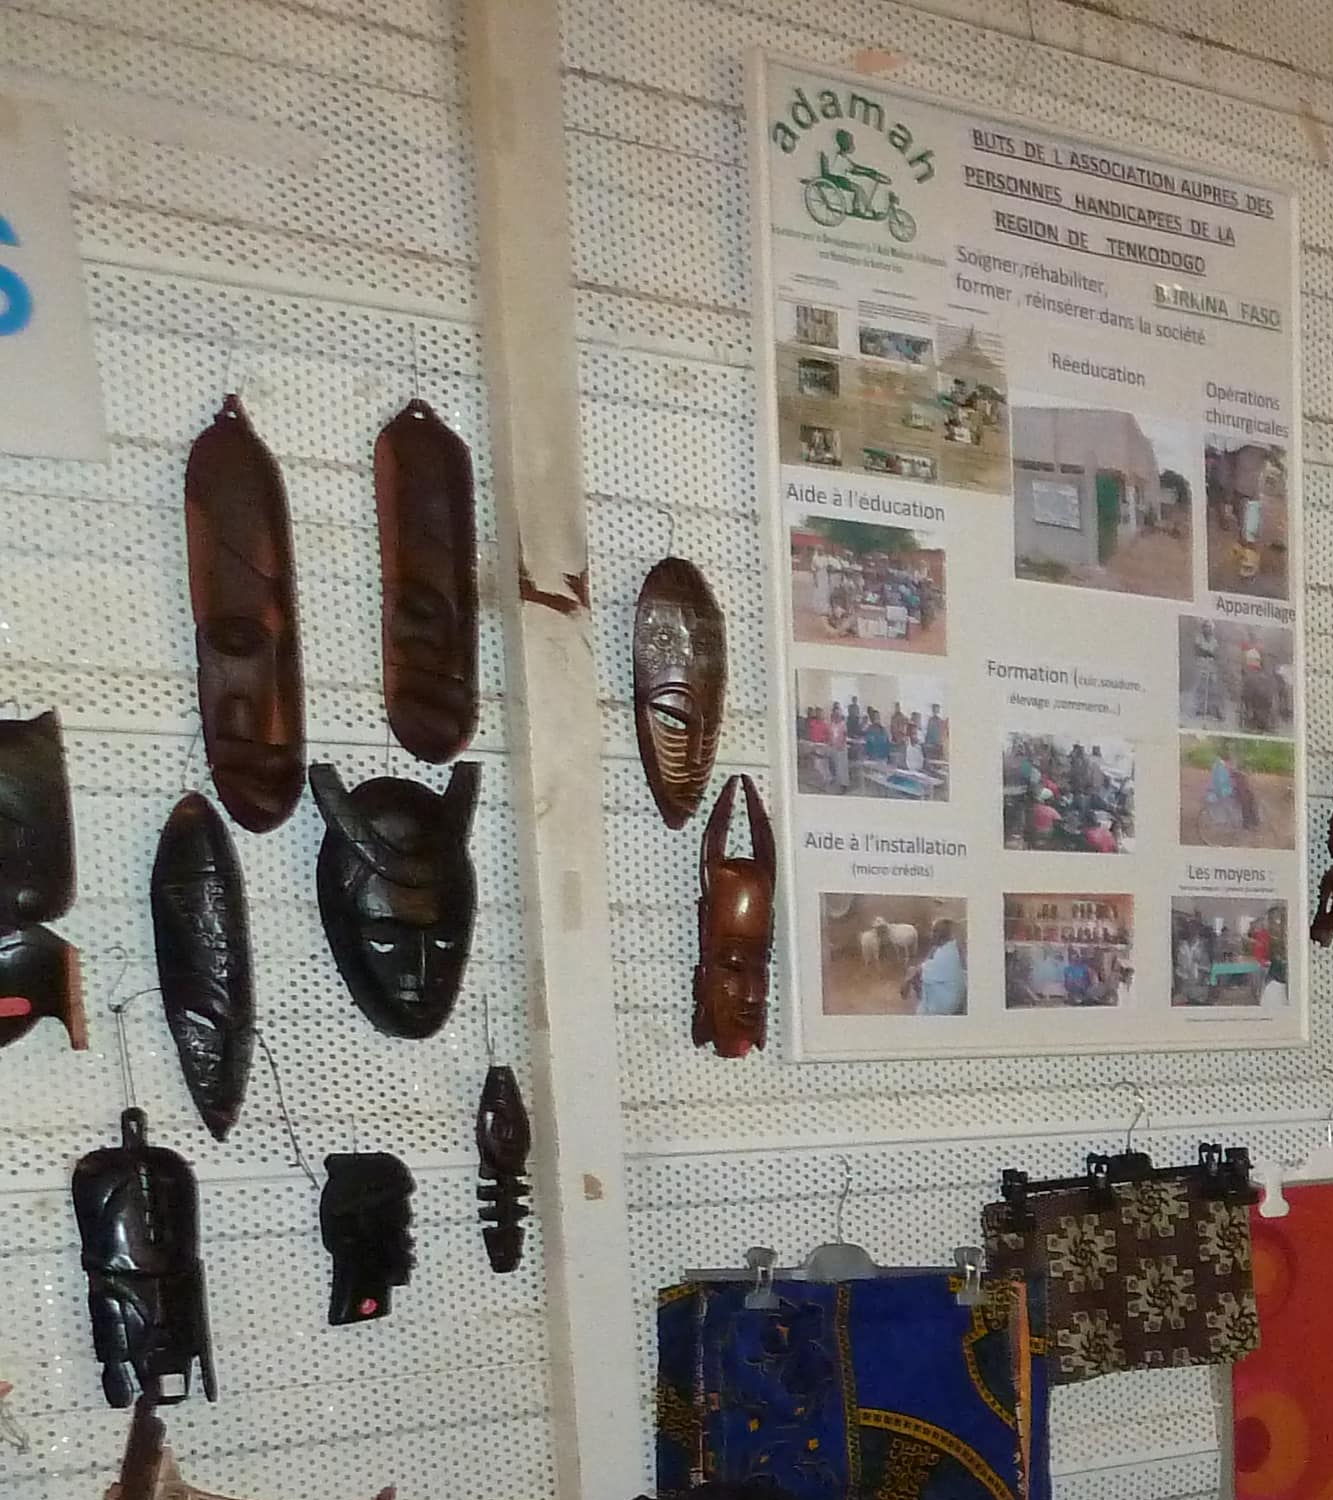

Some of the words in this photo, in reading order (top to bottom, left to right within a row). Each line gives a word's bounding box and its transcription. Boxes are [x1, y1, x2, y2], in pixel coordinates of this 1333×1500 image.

[772, 87, 936, 184] adamah
[972, 128, 1015, 154] BUTS
[1025, 141, 1046, 161] DE
[1180, 179, 1239, 207] AUPRES
[1246, 193, 1275, 216] DES
[964, 165, 1063, 203] PERSONNES
[1074, 193, 1182, 232] HANDICAPEES
[1190, 218, 1210, 237] DE
[1217, 226, 1236, 244] LA
[994, 211, 1060, 242] REGION
[1067, 228, 1089, 250] DE
[1106, 237, 1207, 273] TENKODOGO
[1239, 302, 1282, 327] FASO
[1139, 317, 1151, 335] la
[1155, 321, 1206, 346] société
[1205, 381, 1281, 412] Opérations
[1205, 408, 1290, 438] chirurgicales
[786, 482, 828, 505] Aide
[832, 490, 843, 507] à
[1216, 595, 1297, 624] Appareillage
[987, 659, 1069, 685] Formation
[805, 831, 845, 850] Aide
[849, 833, 860, 851] à
[1188, 864, 1210, 880] Les
